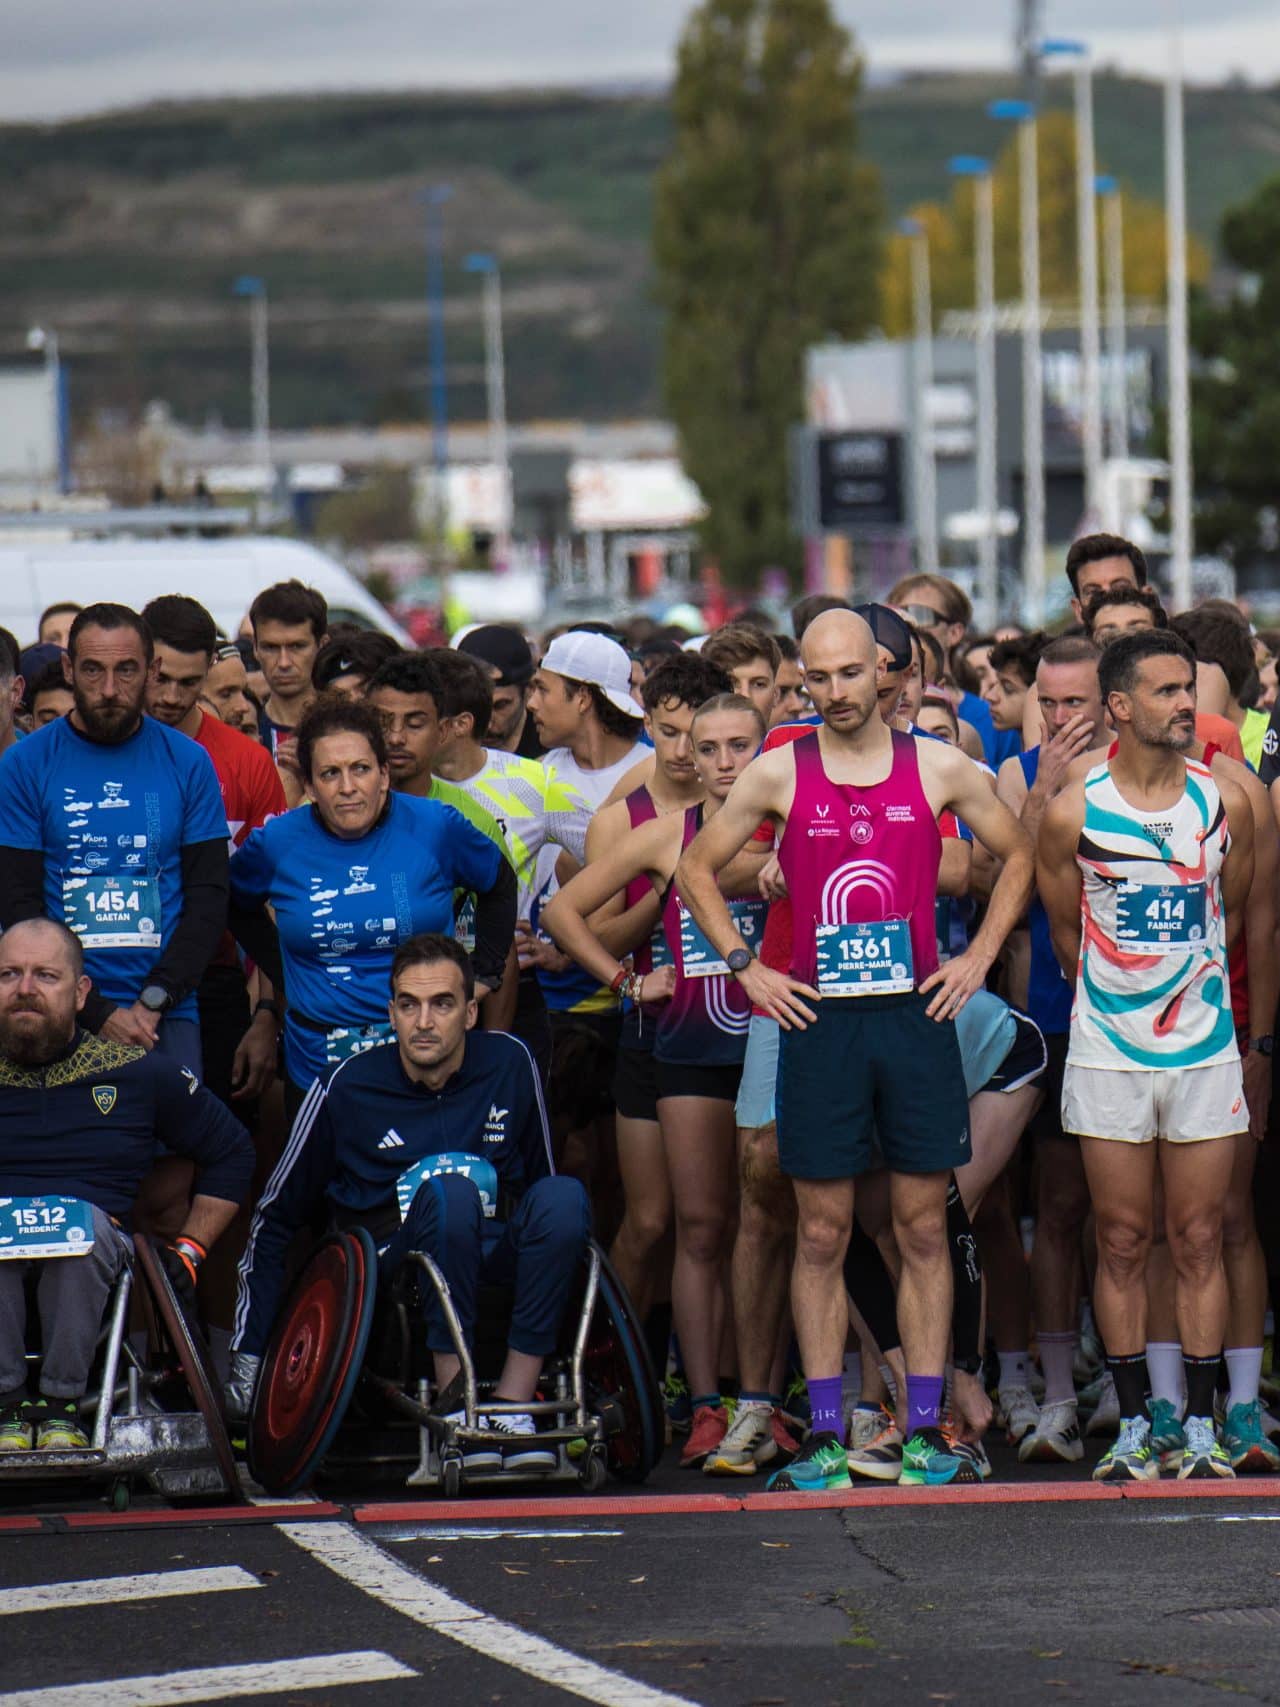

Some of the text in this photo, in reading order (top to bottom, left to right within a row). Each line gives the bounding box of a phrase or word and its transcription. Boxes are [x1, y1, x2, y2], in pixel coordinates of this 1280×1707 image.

[85, 891, 140, 912] 1454
[1145, 899, 1185, 919] 414
[95, 913, 130, 922] GAETAN
[1147, 921, 1182, 930] FABRICE
[838, 937, 891, 960] 1361
[838, 961, 893, 970] PIERRE-MARIE
[12, 1207, 67, 1226] 1512
[19, 1224, 60, 1234] FREDERIC
